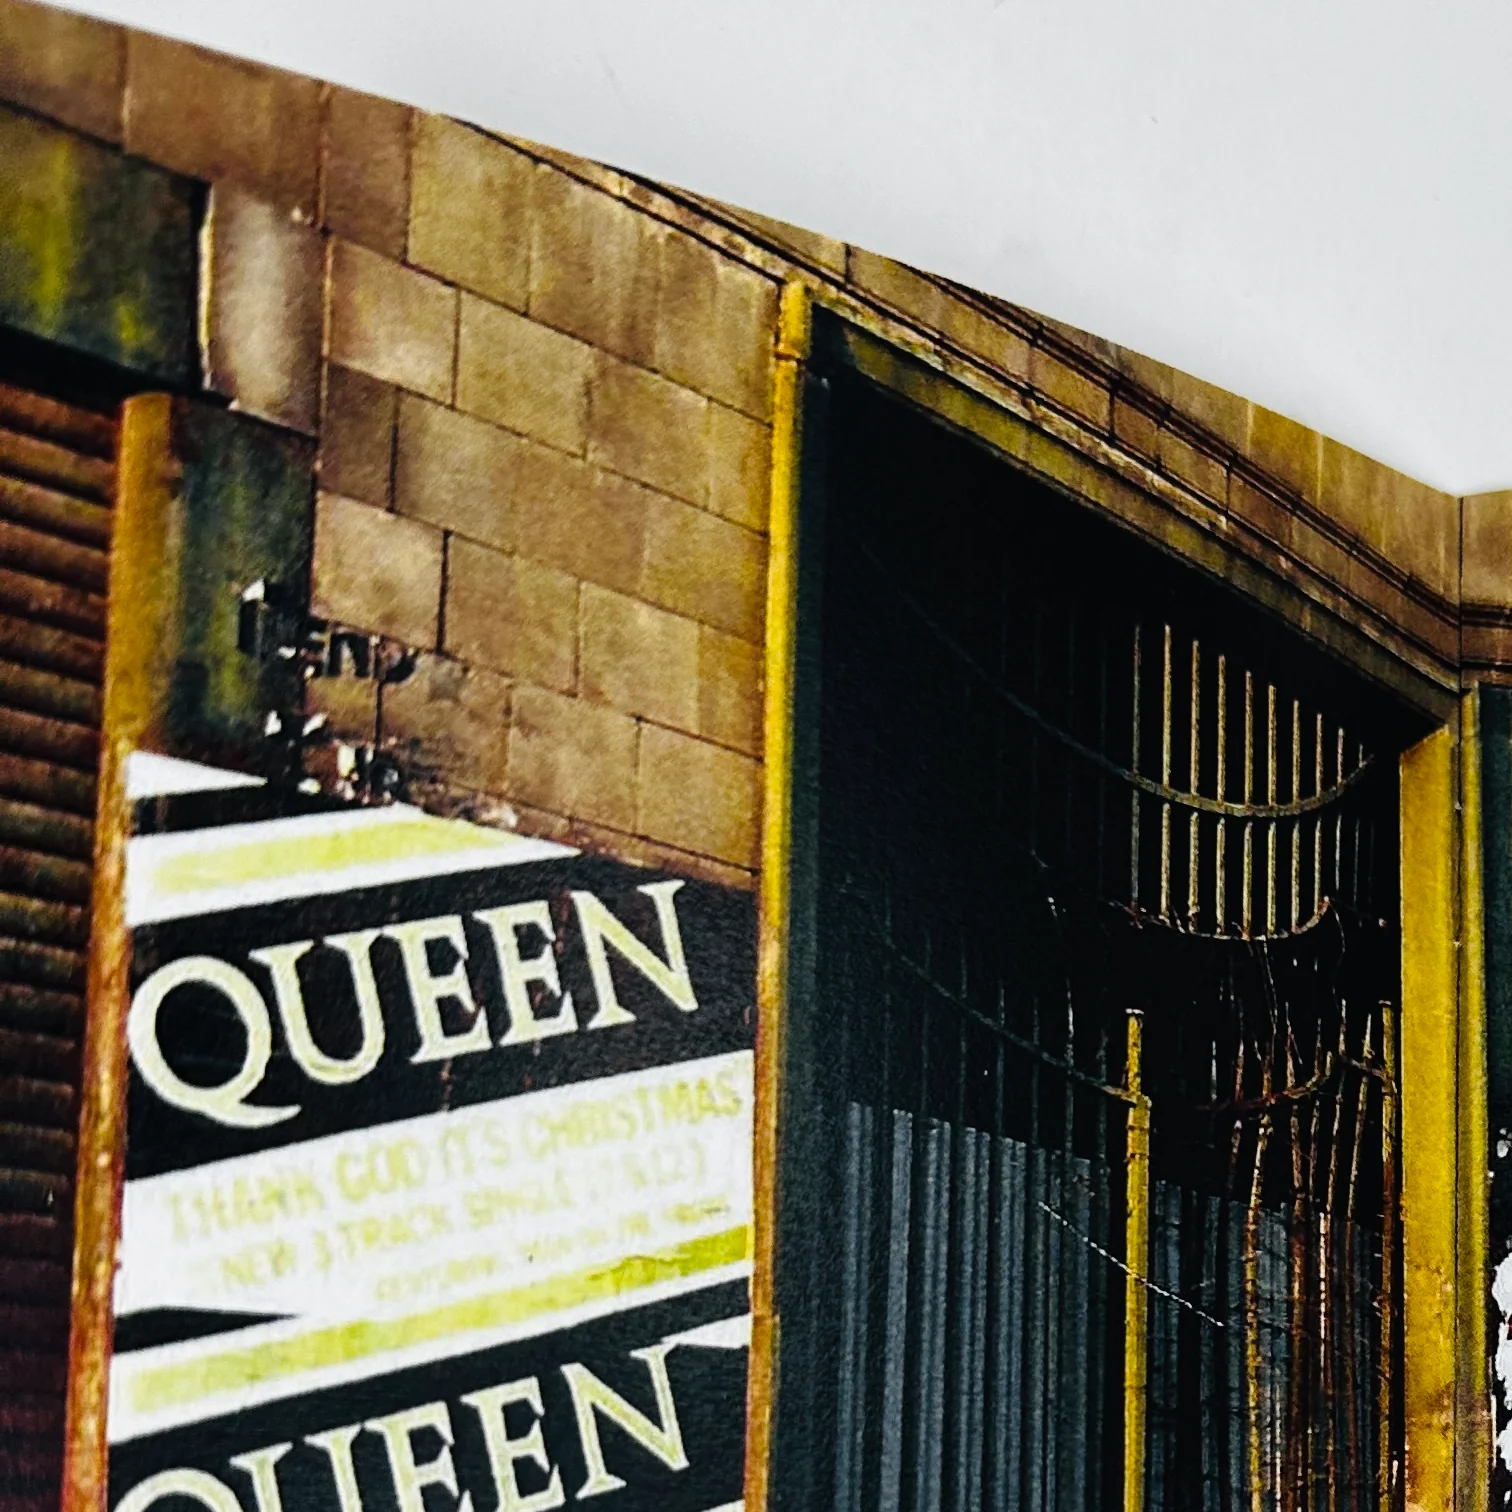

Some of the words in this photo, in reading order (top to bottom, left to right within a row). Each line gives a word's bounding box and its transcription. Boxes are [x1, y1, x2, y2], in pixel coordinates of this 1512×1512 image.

[127, 880, 697, 1129] QUEEN
[334, 1137, 427, 1202] GOD
[520, 1074, 745, 1161] CHRISTMAS
